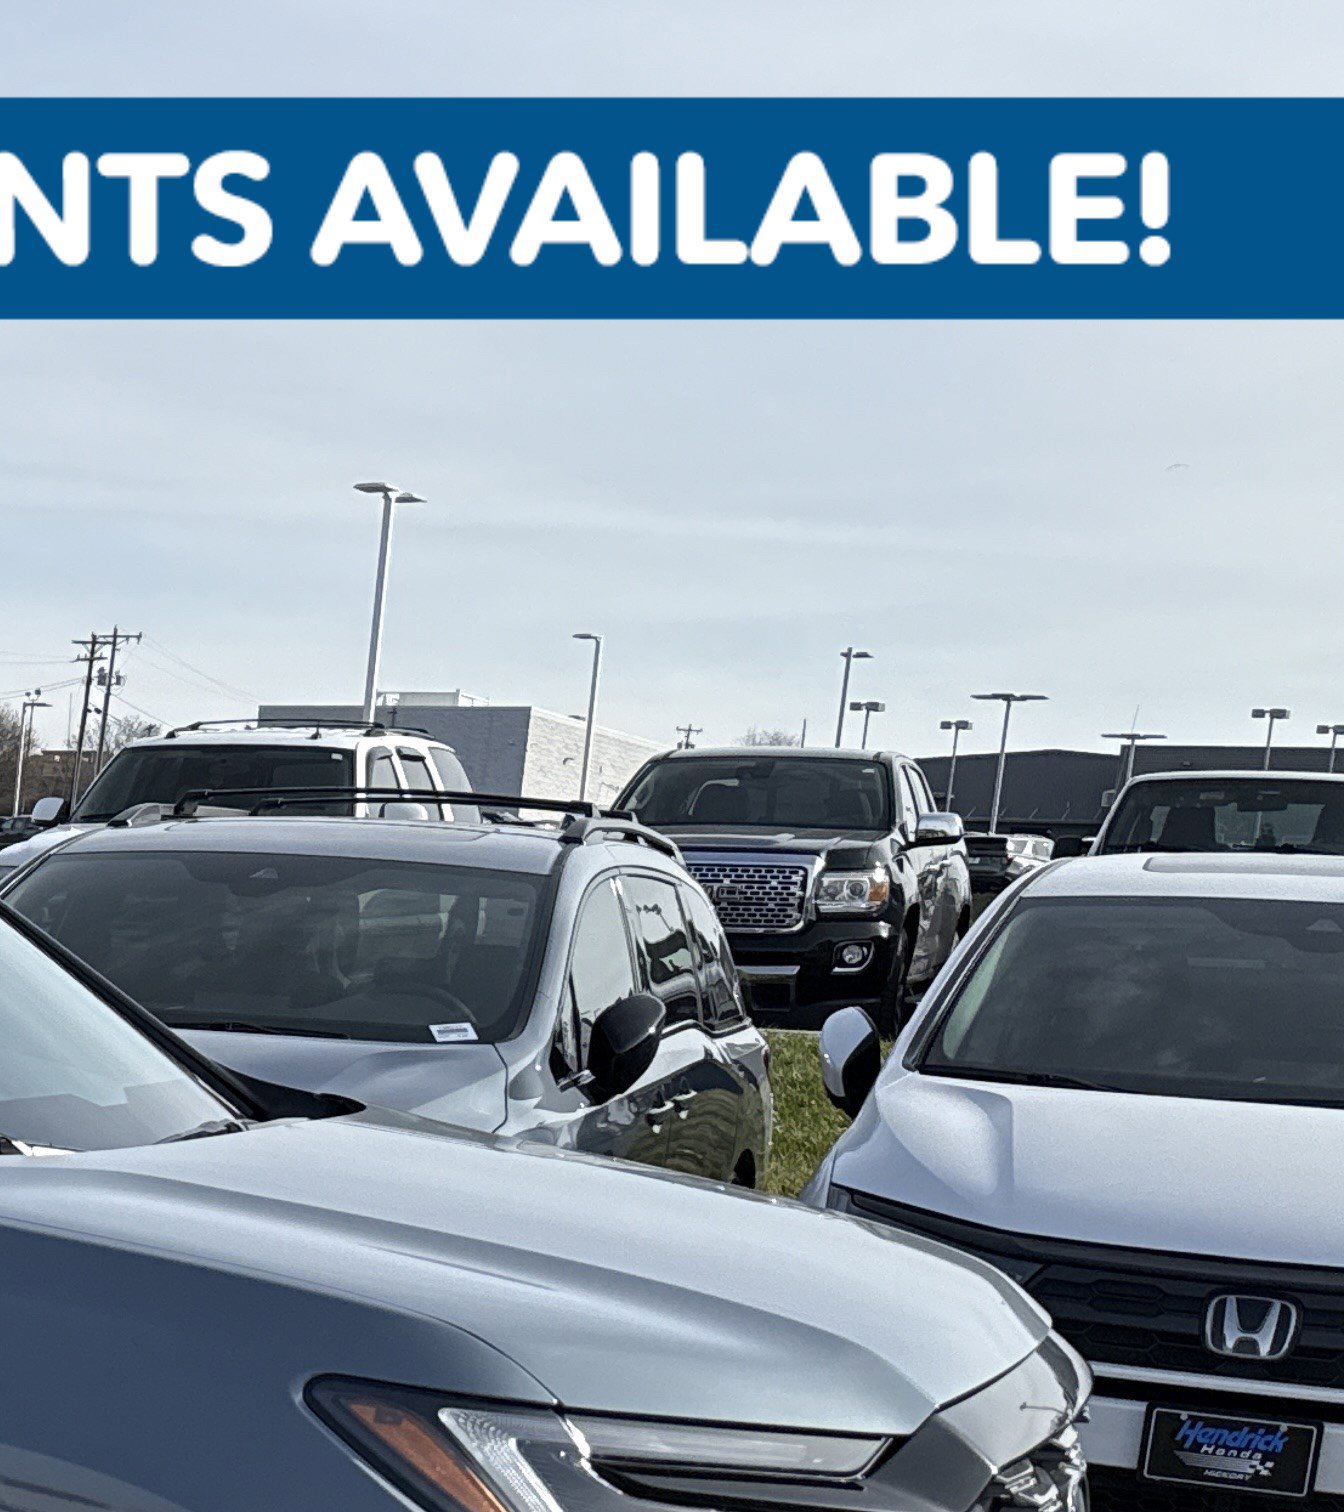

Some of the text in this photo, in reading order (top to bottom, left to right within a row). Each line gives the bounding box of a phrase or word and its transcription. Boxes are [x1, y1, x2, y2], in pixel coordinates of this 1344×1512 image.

[1175, 1419, 1289, 1454] Hendrick
[1200, 1444, 1263, 1460] Honda
[1203, 1469, 1255, 1482] HICKORY
